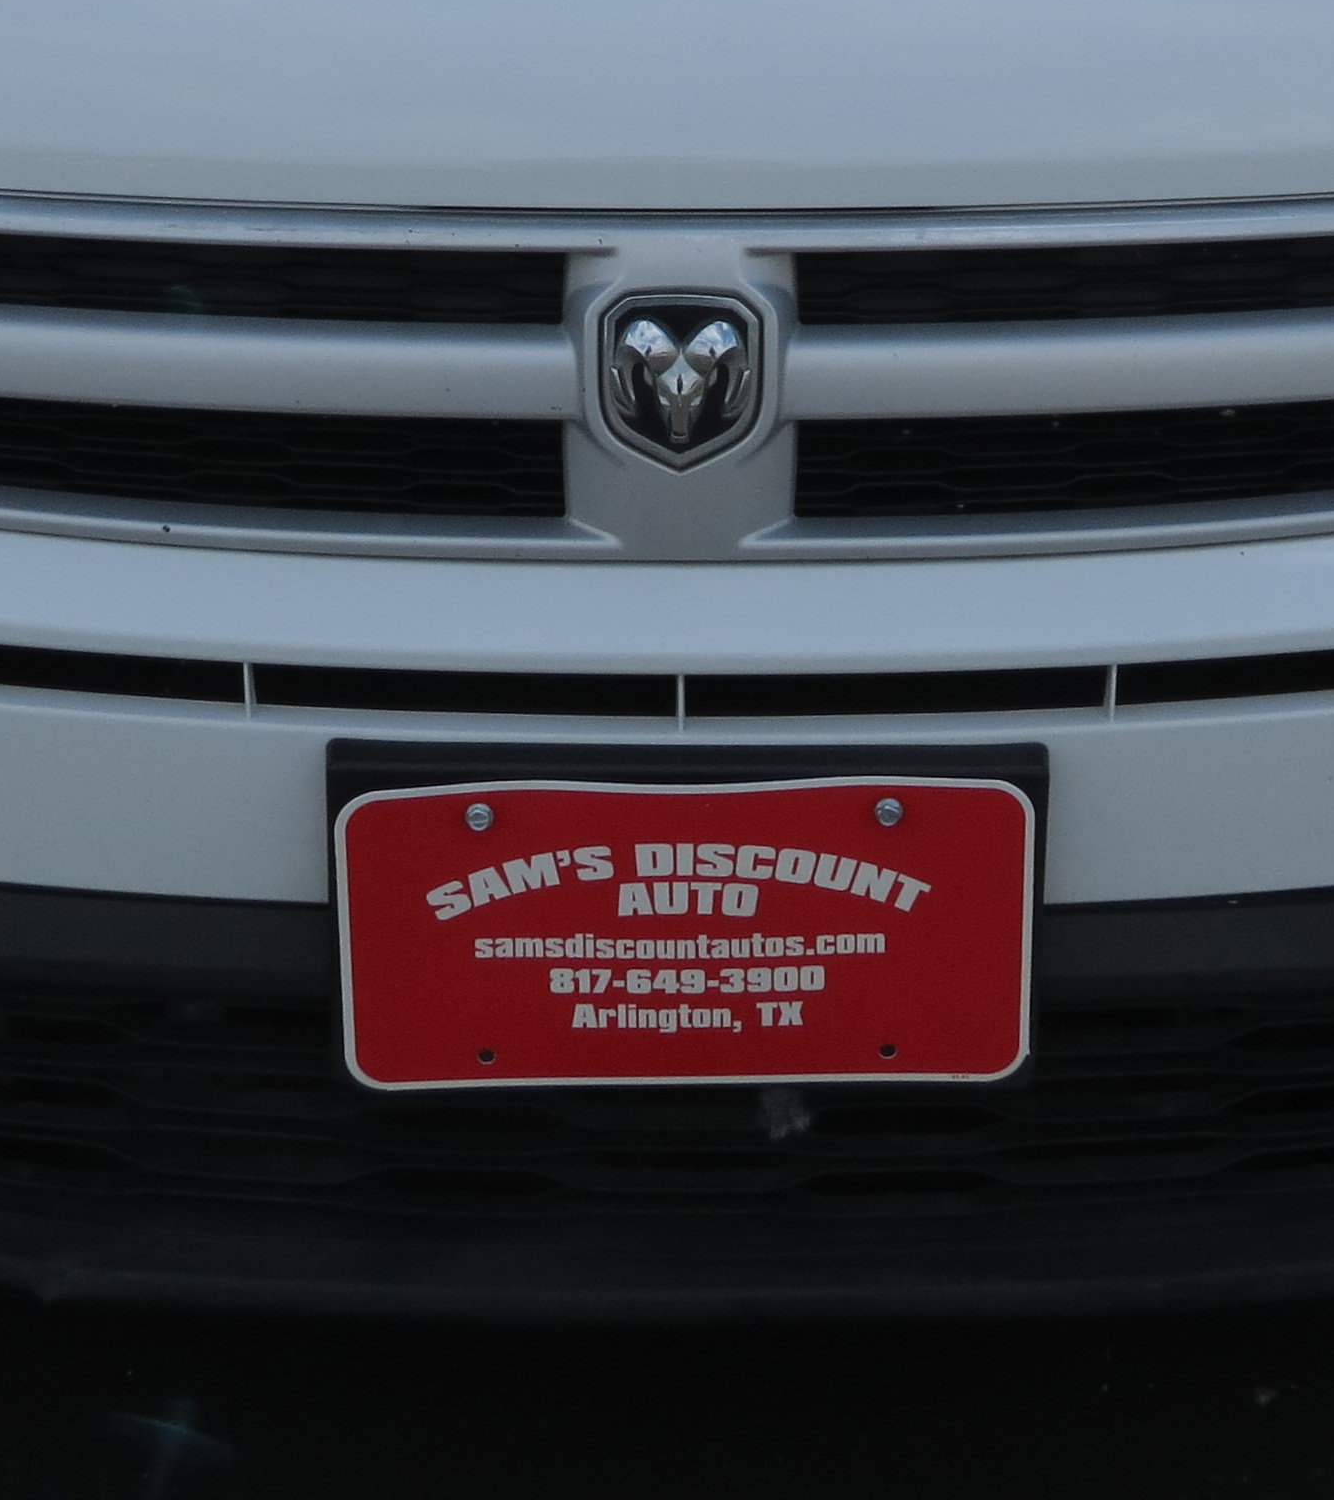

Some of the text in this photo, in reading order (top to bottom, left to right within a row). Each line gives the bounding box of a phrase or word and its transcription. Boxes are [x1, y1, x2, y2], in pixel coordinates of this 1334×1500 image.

[425, 843, 931, 920] SAM'S DISCOUNT
[618, 883, 759, 917] AUTO
[474, 932, 886, 960] samsdiscountautos.com
[549, 966, 825, 994] 817-649-3900
[572, 1002, 803, 1033] Arlington, TX
